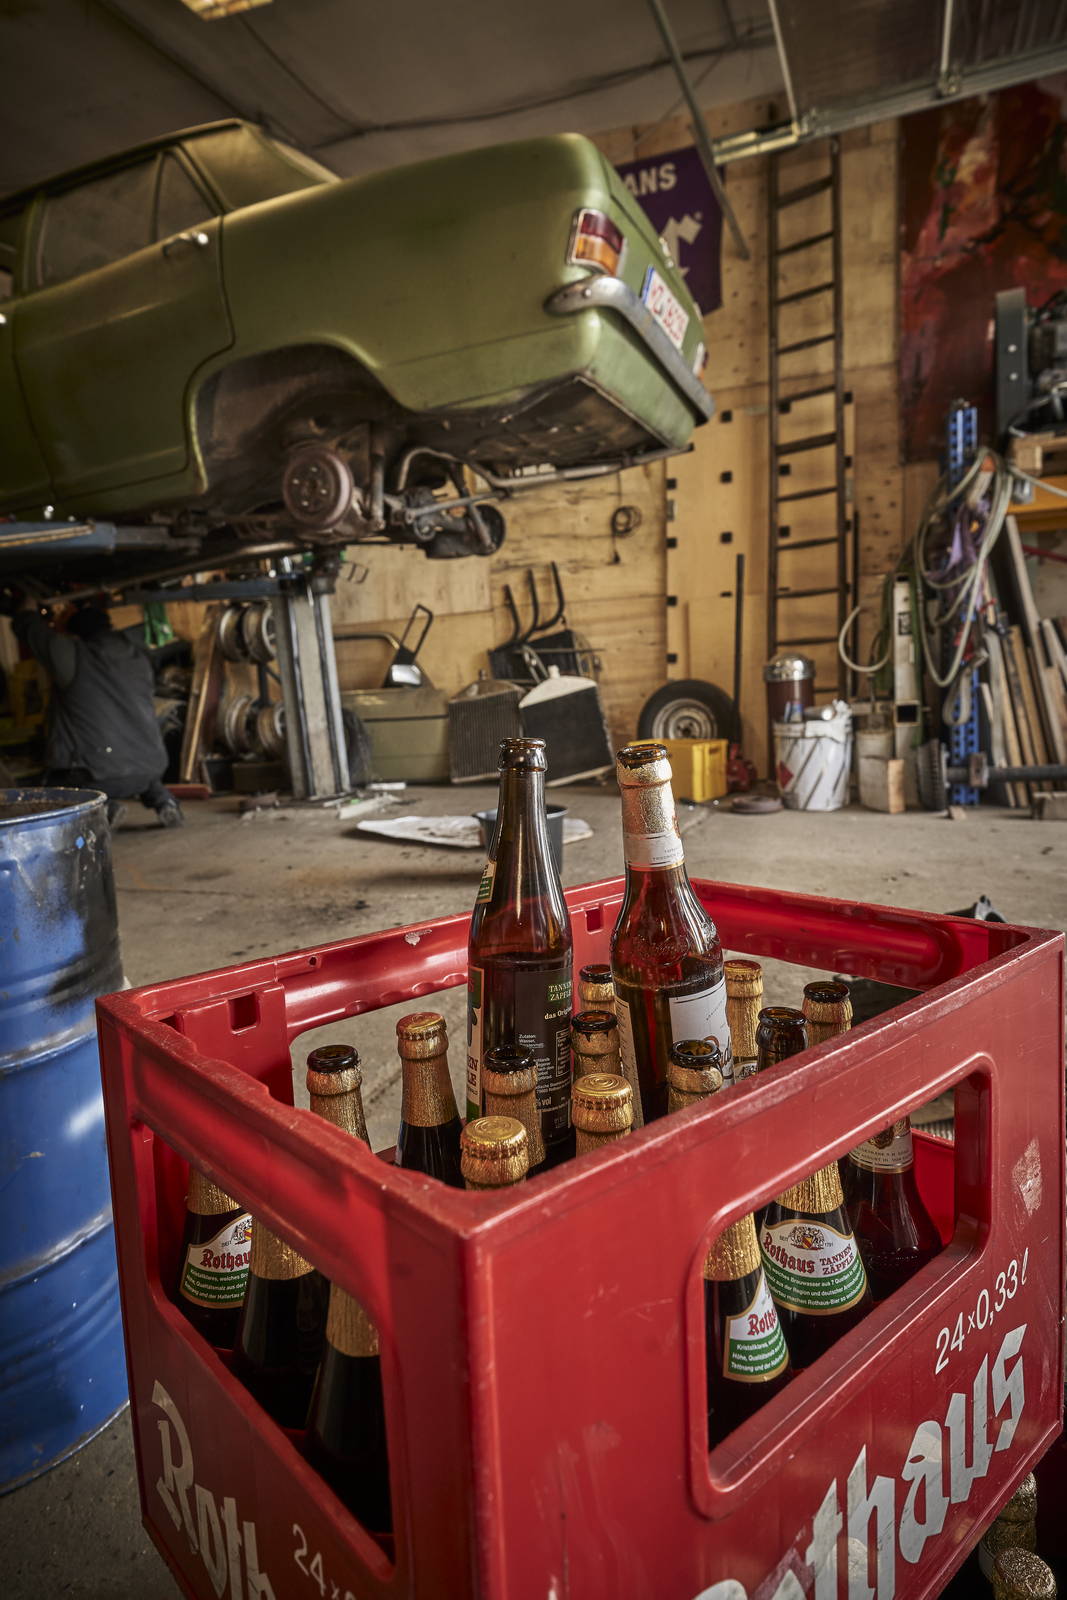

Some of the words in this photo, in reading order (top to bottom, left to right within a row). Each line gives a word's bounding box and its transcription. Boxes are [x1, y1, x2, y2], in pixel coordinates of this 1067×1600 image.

[542, 1096, 552, 1106] vol
[200, 1249, 251, 1271] Rothau
[763, 1232, 815, 1274] Rothaus
[819, 1243, 853, 1267] TANNEN
